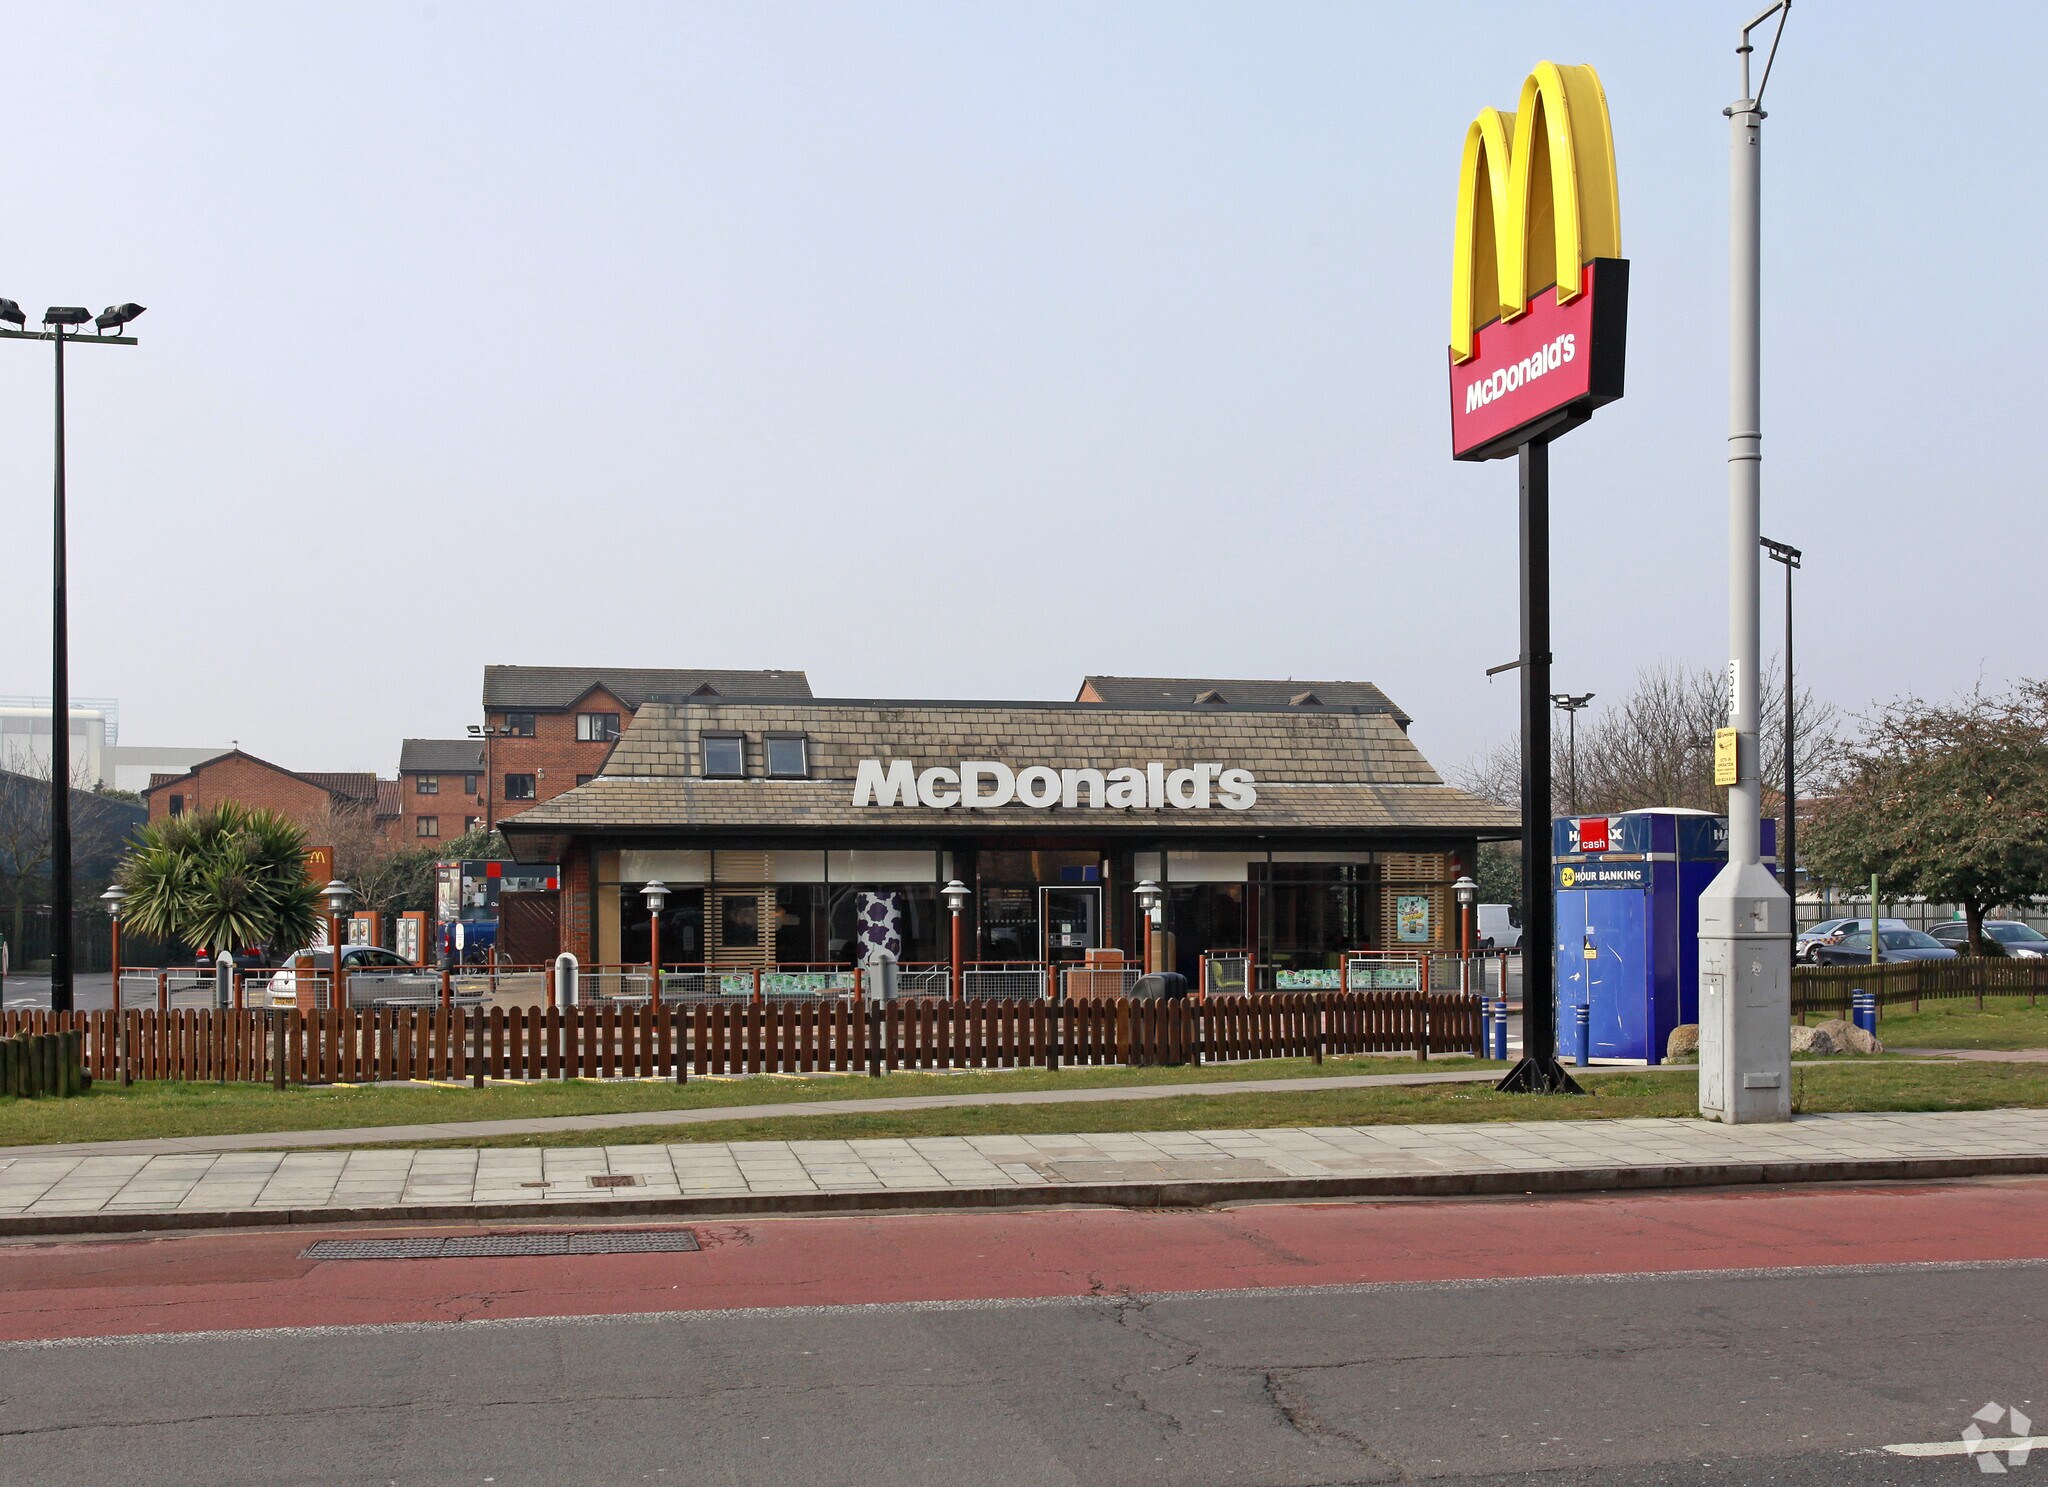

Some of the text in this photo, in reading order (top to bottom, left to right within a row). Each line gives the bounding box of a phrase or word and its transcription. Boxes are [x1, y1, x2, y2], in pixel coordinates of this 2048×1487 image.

[1466, 334, 1576, 414] McDonald's
[853, 759, 1257, 811] McDonald's
[1583, 839, 1605, 849] cash
[1575, 872, 1597, 881] HOUR
[1599, 871, 1641, 881] BANKING
